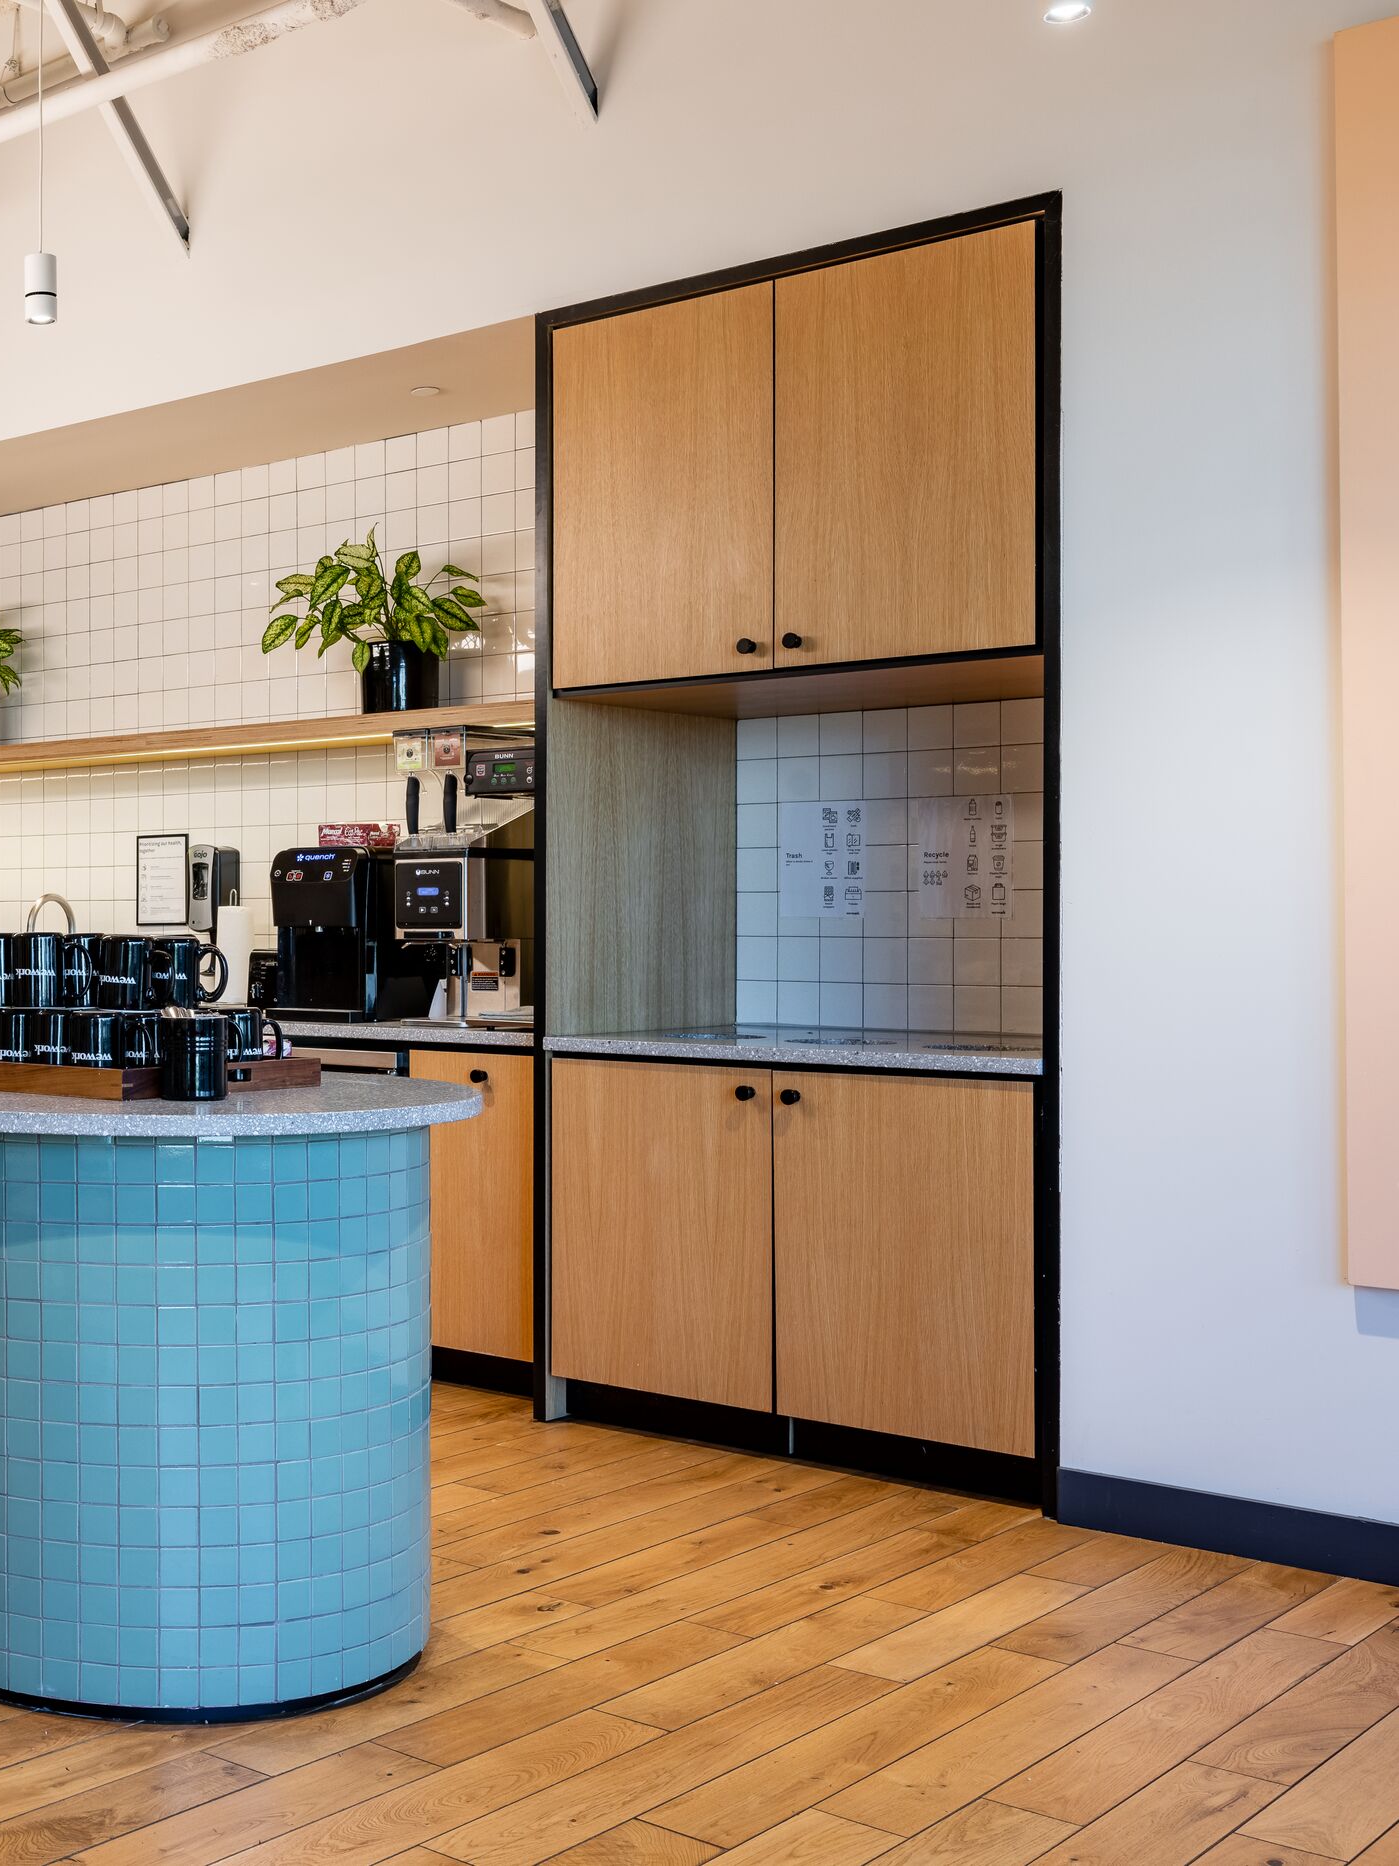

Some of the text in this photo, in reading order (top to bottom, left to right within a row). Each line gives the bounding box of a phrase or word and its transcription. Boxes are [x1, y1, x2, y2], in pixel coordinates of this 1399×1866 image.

[304, 853, 334, 861] quench
[923, 851, 950, 860] Recycle
[15, 968, 56, 979] wework
[71, 1051, 112, 1064] wework
[227, 1048, 263, 1059] wewrk
